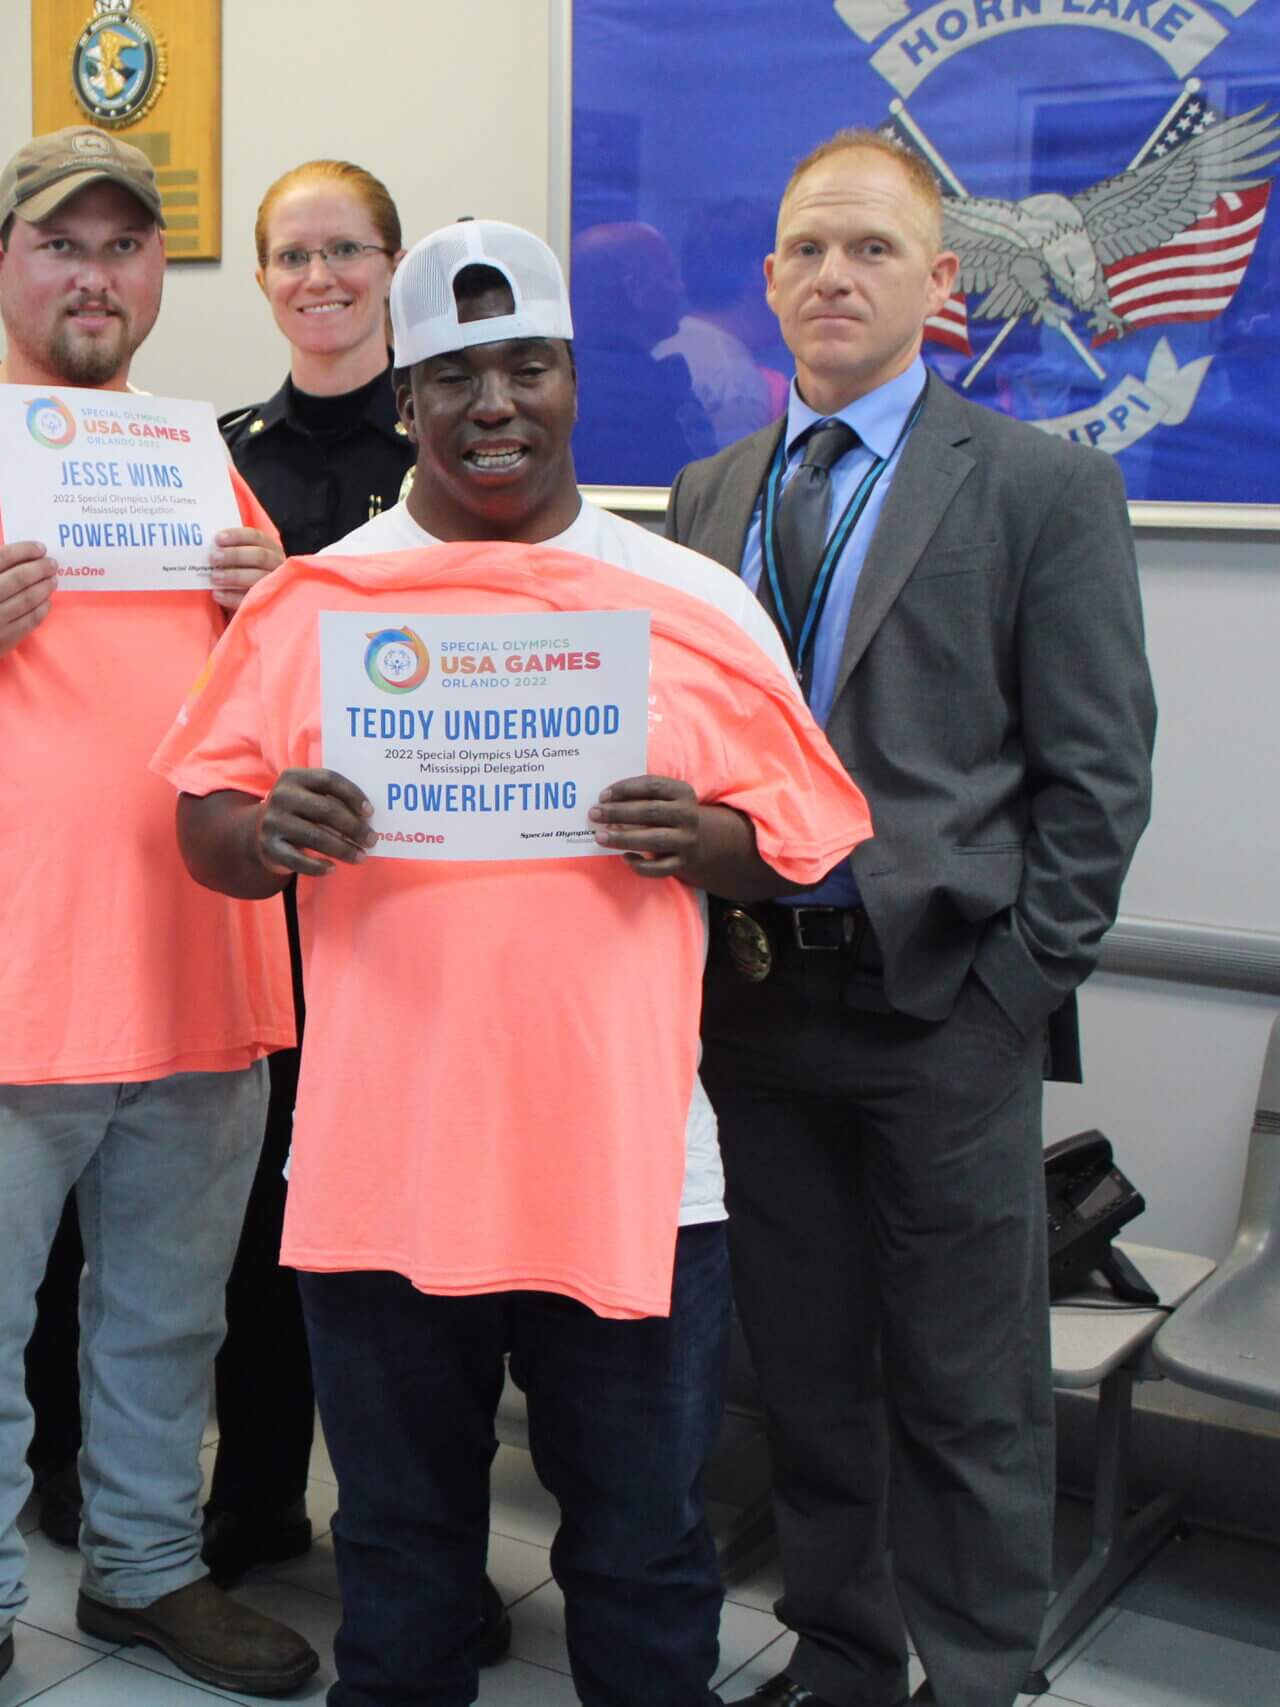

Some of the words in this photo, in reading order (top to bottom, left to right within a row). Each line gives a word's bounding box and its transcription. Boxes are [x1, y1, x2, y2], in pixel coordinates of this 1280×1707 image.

[899, 0, 1041, 67] HORN
[81, 408, 120, 418] SPECIAL
[84, 418, 124, 434] USA
[128, 422, 191, 443] GAMES
[87, 436, 136, 447] ORLANDO
[61, 461, 122, 486] JESSE
[127, 463, 183, 488] WIMS
[53, 494, 75, 504] 2022
[78, 494, 107, 505] Special
[109, 494, 149, 505] Olympics
[150, 495, 168, 504] USA
[170, 496, 197, 505] Games
[81, 505, 128, 516] Mississippi
[58, 523, 204, 548] POWERLIFTING
[57, 566, 105, 577] eAsOne
[441, 641, 498, 652] SPECIAL
[502, 638, 570, 651] OLYMPICS
[440, 655, 496, 674] USA
[505, 651, 601, 674] GAMES
[441, 677, 510, 688] ORLANDO
[514, 676, 547, 687] 2022
[346, 706, 435, 740] TEDDY
[445, 704, 620, 740] UNDERWOOD
[384, 749, 413, 760] 2022
[417, 749, 455, 762] Special
[458, 749, 511, 762] Olympics
[515, 748, 539, 759] USA
[542, 747, 580, 758] Games
[420, 763, 480, 775] Mississippi
[484, 761, 545, 775] Delegation
[387, 781, 577, 812] POWERLIFTING
[376, 831, 445, 844] neAsOne
